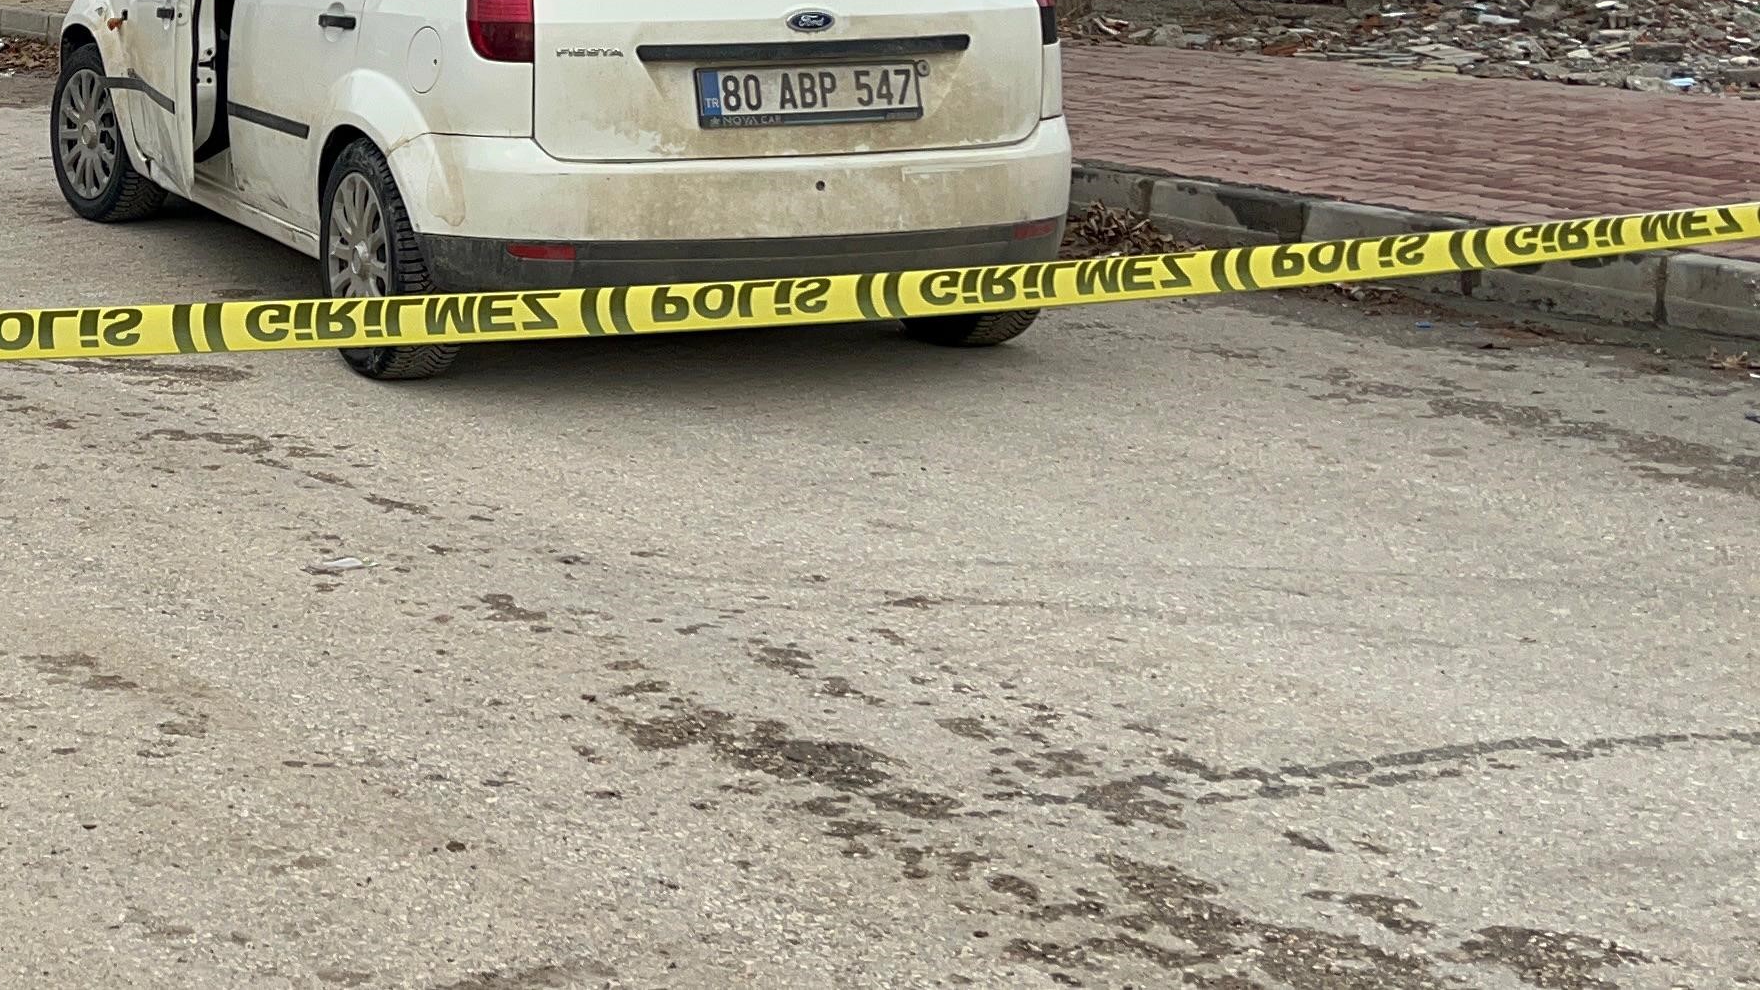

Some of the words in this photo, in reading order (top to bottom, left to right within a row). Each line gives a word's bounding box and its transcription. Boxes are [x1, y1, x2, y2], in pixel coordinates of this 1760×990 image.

[705, 97, 720, 108] TR
[721, 73, 763, 112] 80
[779, 71, 837, 109] ABP
[854, 68, 911, 107] 547
